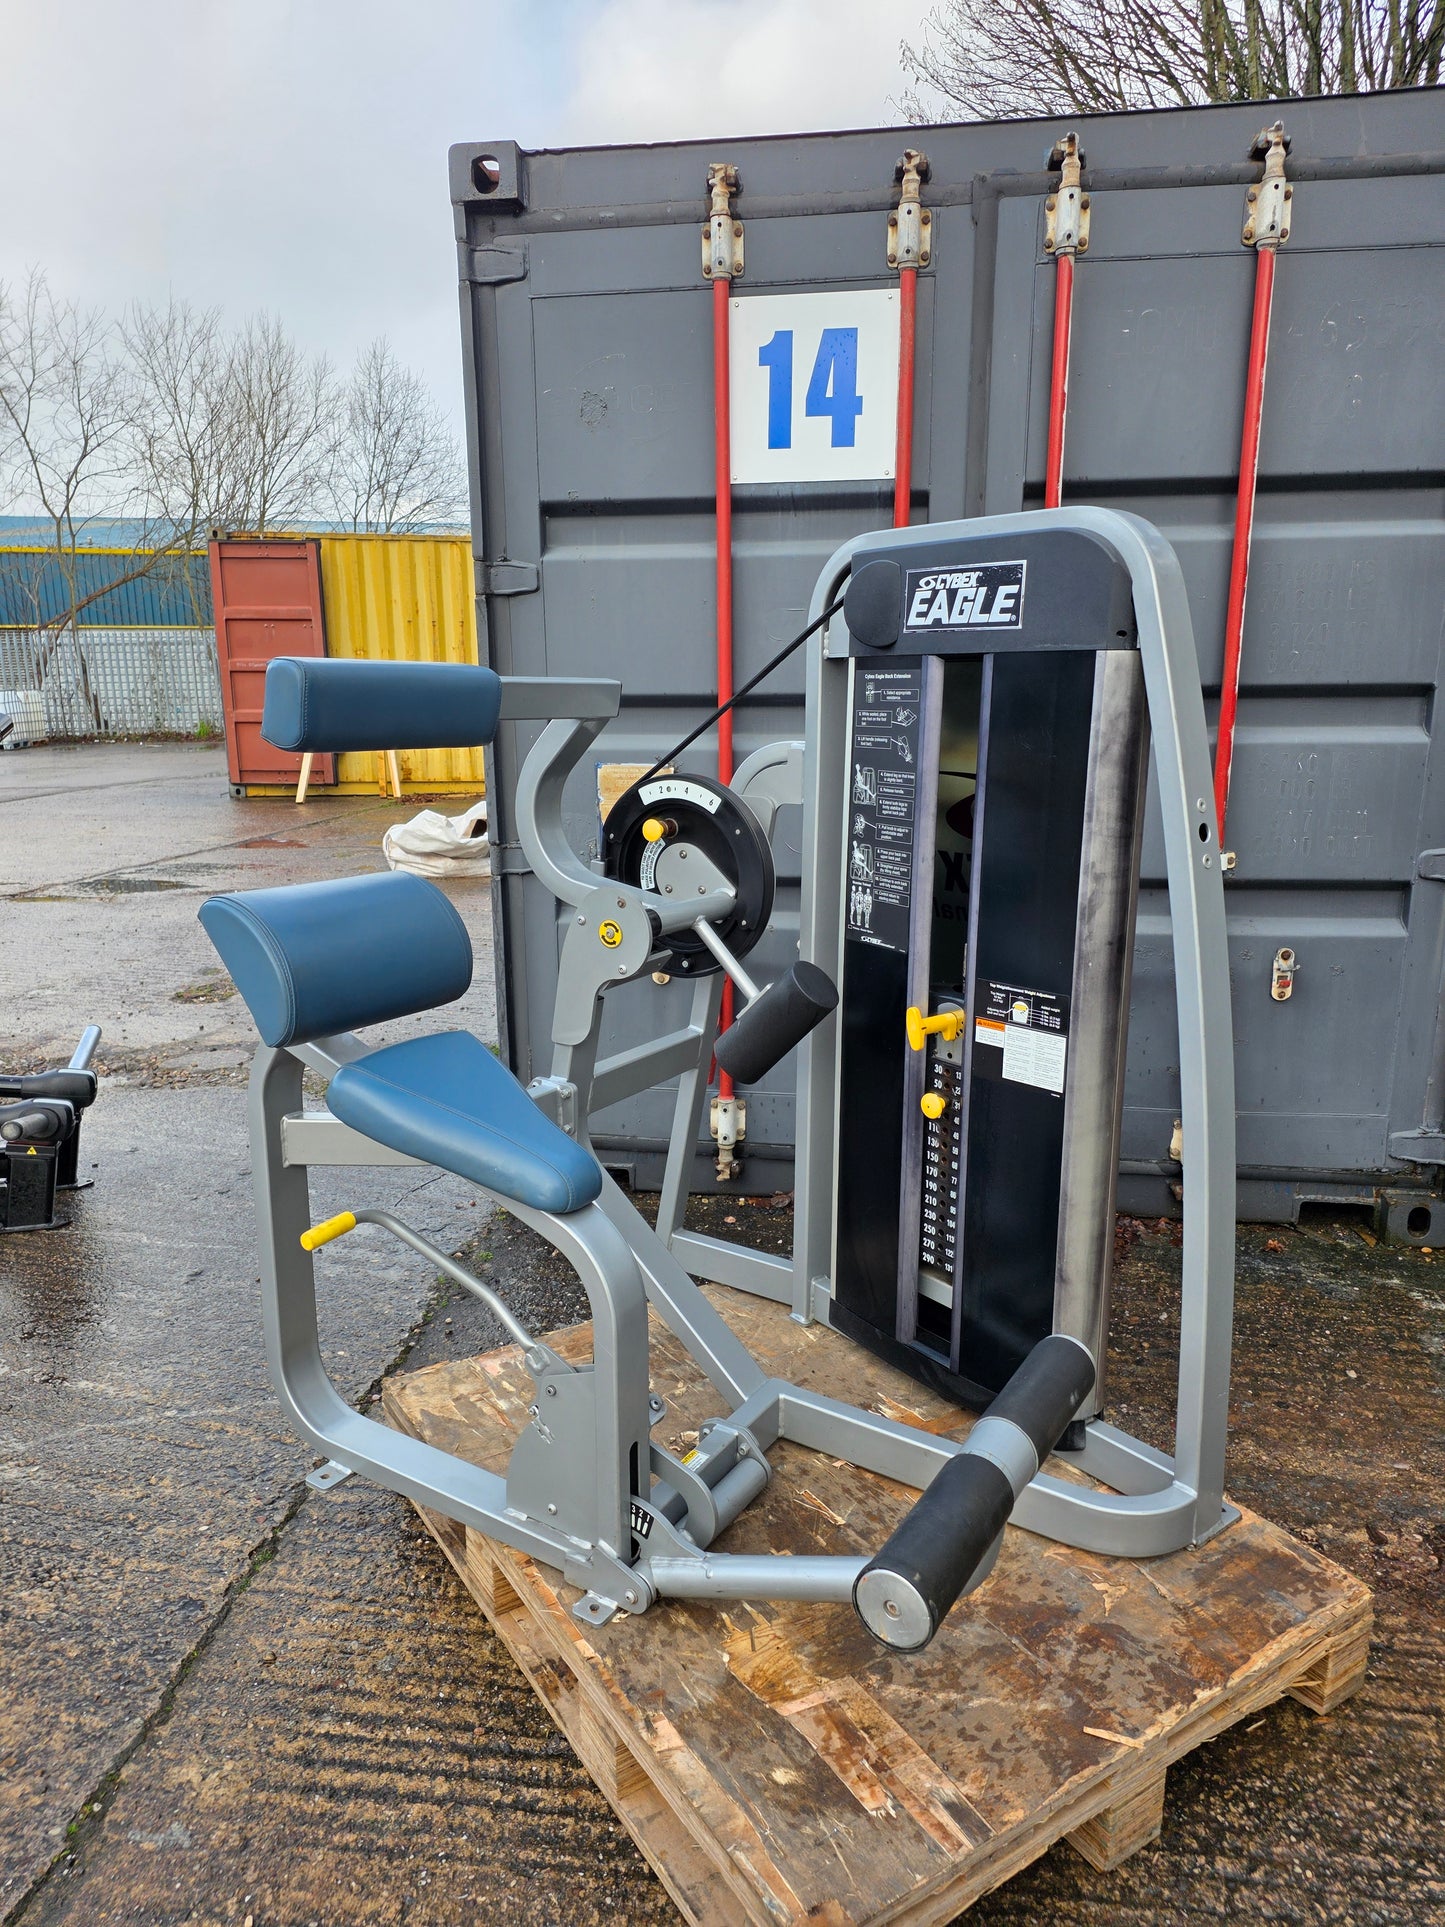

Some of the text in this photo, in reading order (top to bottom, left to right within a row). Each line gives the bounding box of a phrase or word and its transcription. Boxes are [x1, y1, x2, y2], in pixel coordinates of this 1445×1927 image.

[759, 327, 863, 449] 14
[932, 572, 981, 591] CYBEX
[907, 585, 1020, 626] EAGLE
[659, 786, 663, 794] 2
[934, 1064, 943, 1074] 30
[934, 1079, 942, 1089] 50
[928, 1136, 939, 1148] 130
[927, 1151, 938, 1162] 150
[926, 1166, 957, 1185] 170 77
[925, 1180, 937, 1192] 190
[925, 1194, 937, 1206] 210
[924, 1209, 955, 1229] 230 104
[924, 1223, 954, 1244] 250 113
[923, 1238, 954, 1258] 270 122
[922, 1252, 934, 1264] 290
[639, 1509, 644, 1517] 2
